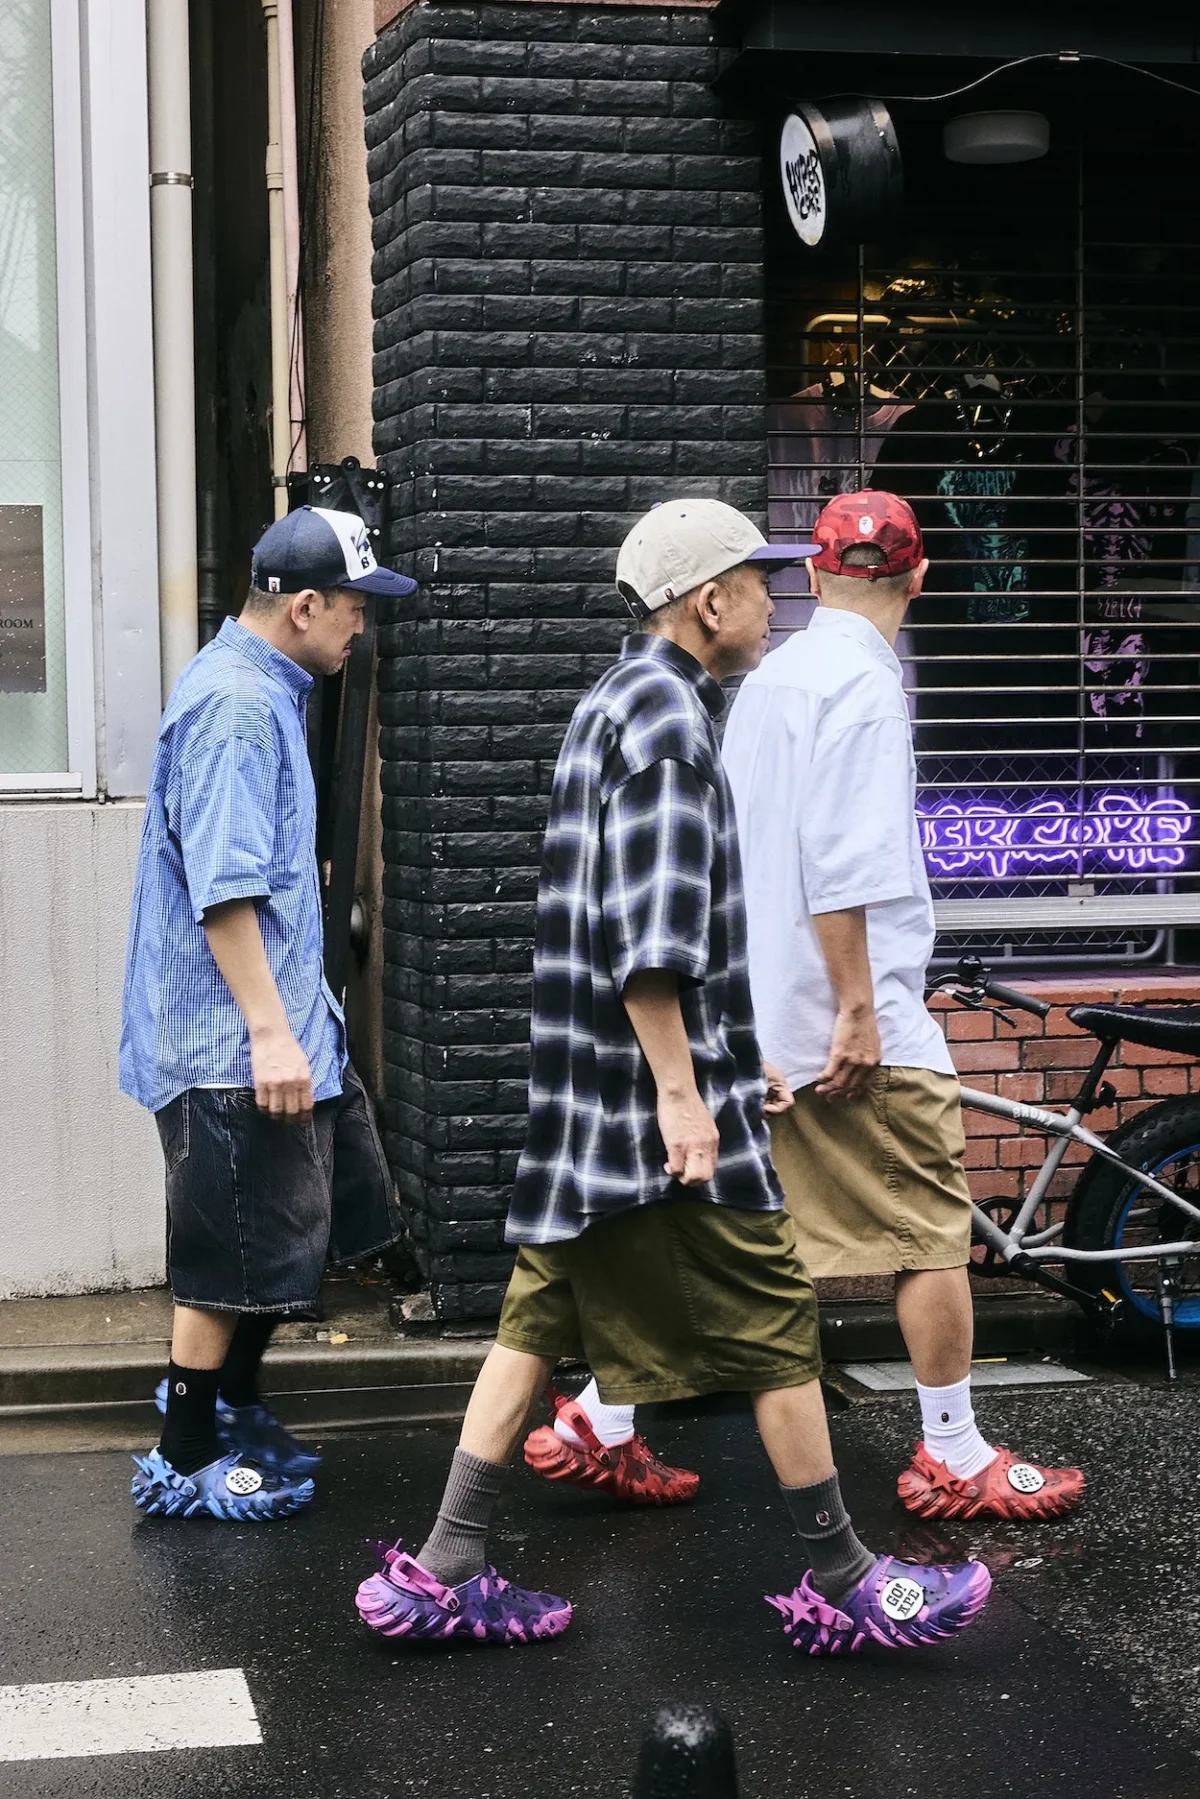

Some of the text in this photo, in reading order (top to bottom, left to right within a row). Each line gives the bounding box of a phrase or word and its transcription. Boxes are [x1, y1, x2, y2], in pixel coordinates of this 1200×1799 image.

[786, 149, 821, 215] HYPER
[800, 185, 821, 220] CORE
[1012, 1105, 1056, 1127] BRONX
[886, 1583, 907, 1607] GO!
[897, 1589, 920, 1617] APE
